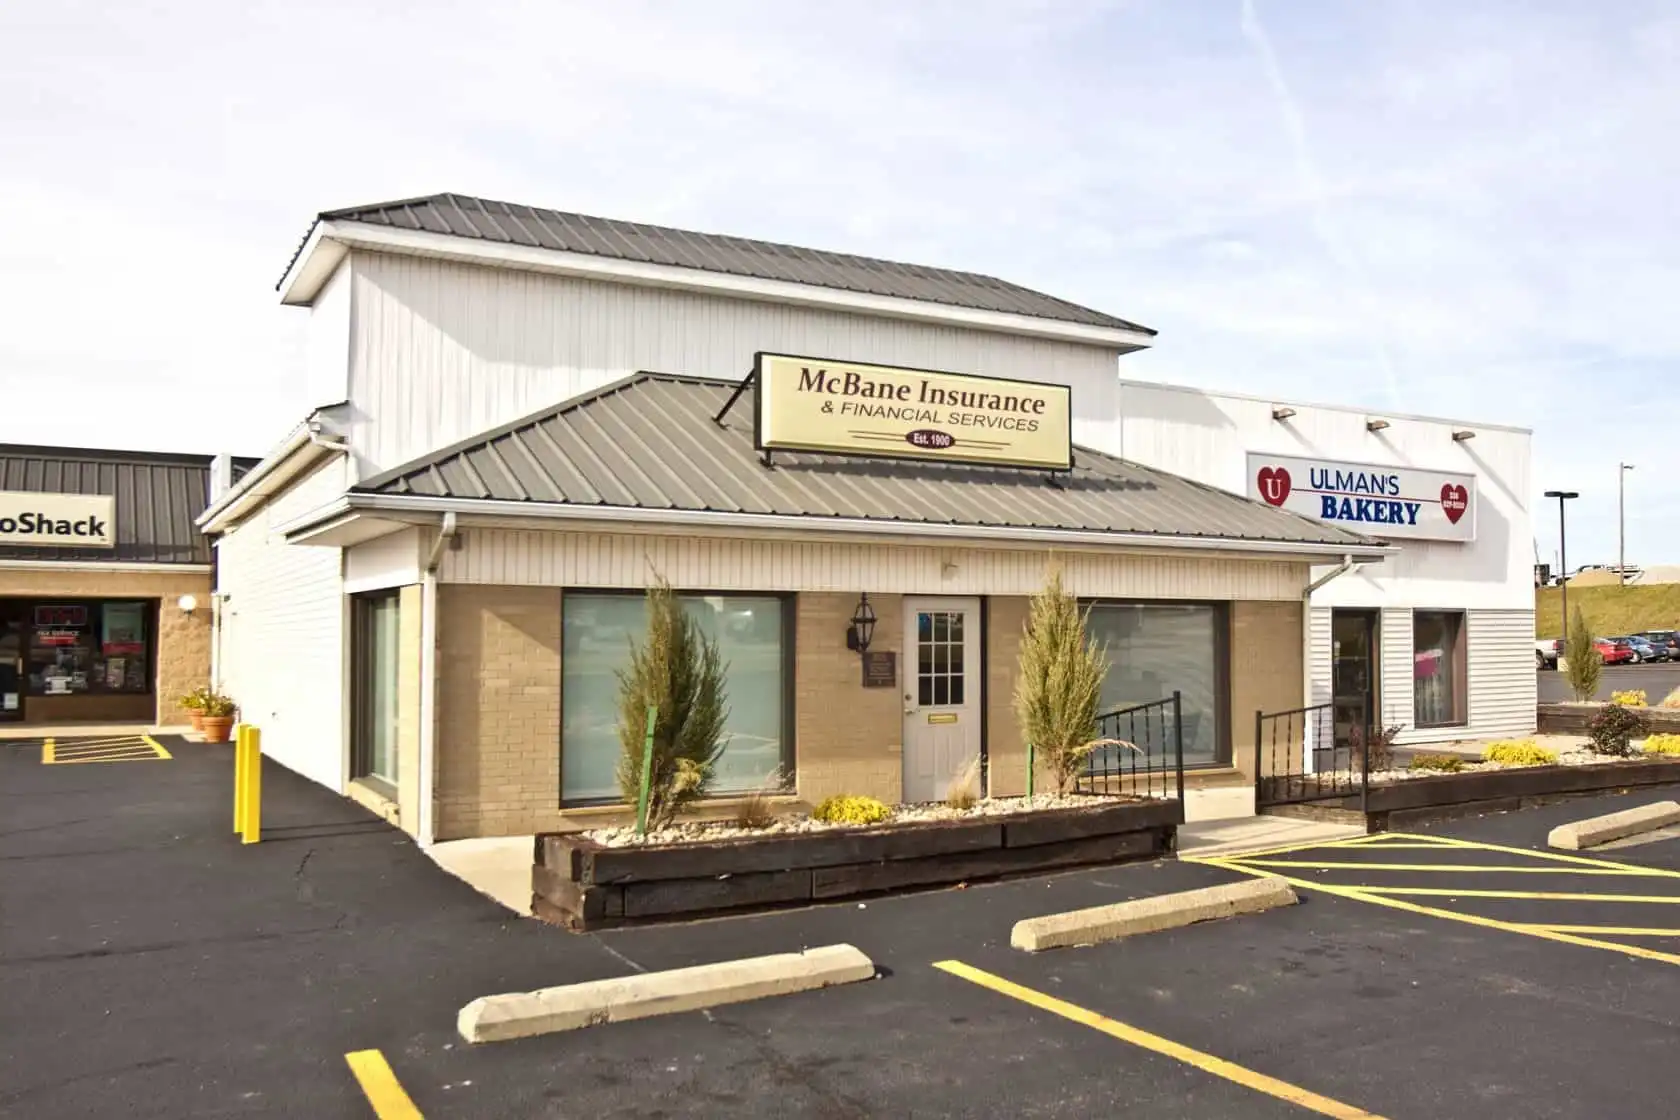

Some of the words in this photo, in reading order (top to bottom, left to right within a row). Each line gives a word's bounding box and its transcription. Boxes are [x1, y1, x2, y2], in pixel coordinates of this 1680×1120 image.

[797, 367, 911, 401] McBane
[918, 380, 1045, 414] Insurance
[820, 400, 834, 414] &
[840, 401, 943, 424] FINANCIAL
[948, 412, 1039, 432] SERVICES
[913, 432, 929, 445] Est.
[1265, 478, 1281, 500] U
[1310, 468, 1399, 496] ULMAN'S
[1321, 496, 1421, 525] BAKERY
